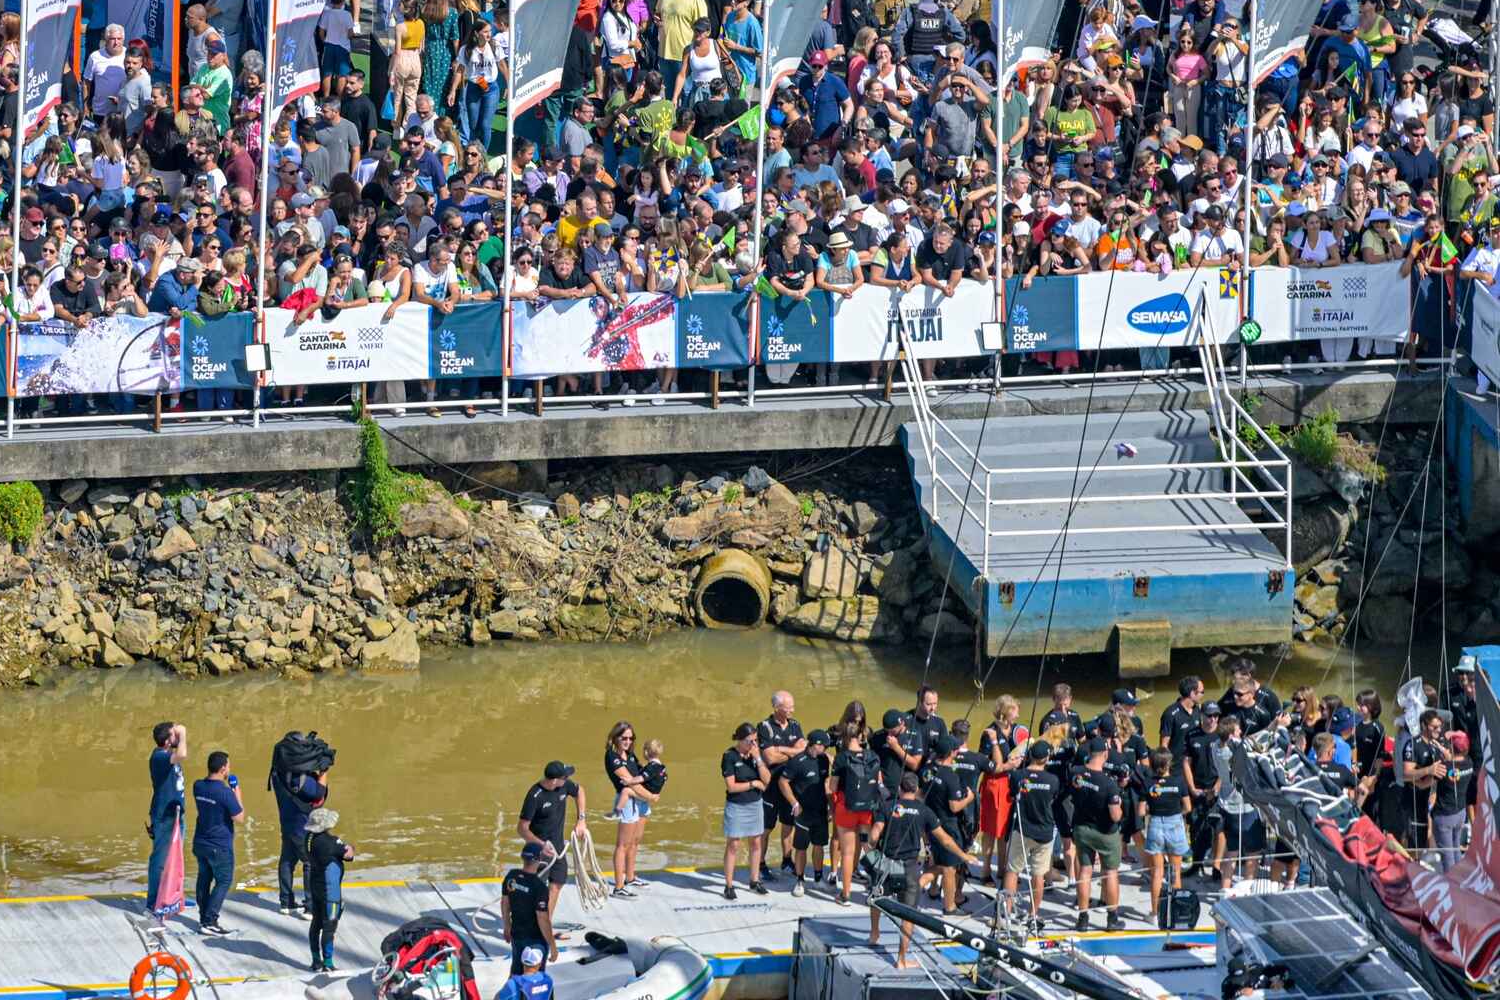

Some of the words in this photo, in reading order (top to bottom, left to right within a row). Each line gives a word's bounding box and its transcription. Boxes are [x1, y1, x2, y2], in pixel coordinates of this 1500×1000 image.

[1286, 284, 1317, 293] SANTA
[1286, 290, 1332, 299] CATARINA
[1131, 310, 1188, 324] SEMASA
[299, 335, 330, 343] SANTA
[686, 335, 703, 343] THE
[768, 336, 784, 345] THE
[1013, 332, 1047, 342] OCEAN
[299, 342, 347, 351] CATARINA
[686, 342, 721, 351] OCEAN
[768, 343, 802, 353] OCEAN
[1013, 341, 1037, 350] RACE
[440, 350, 457, 358] THE
[687, 350, 710, 359] RACE
[768, 352, 791, 360] RACE
[192, 356, 209, 364] THE
[440, 357, 475, 367] OCEAN
[192, 363, 227, 372] OCEAN
[440, 366, 463, 375] RACE
[192, 371, 216, 380] RACE
[944, 924, 1066, 984] VOLVO
